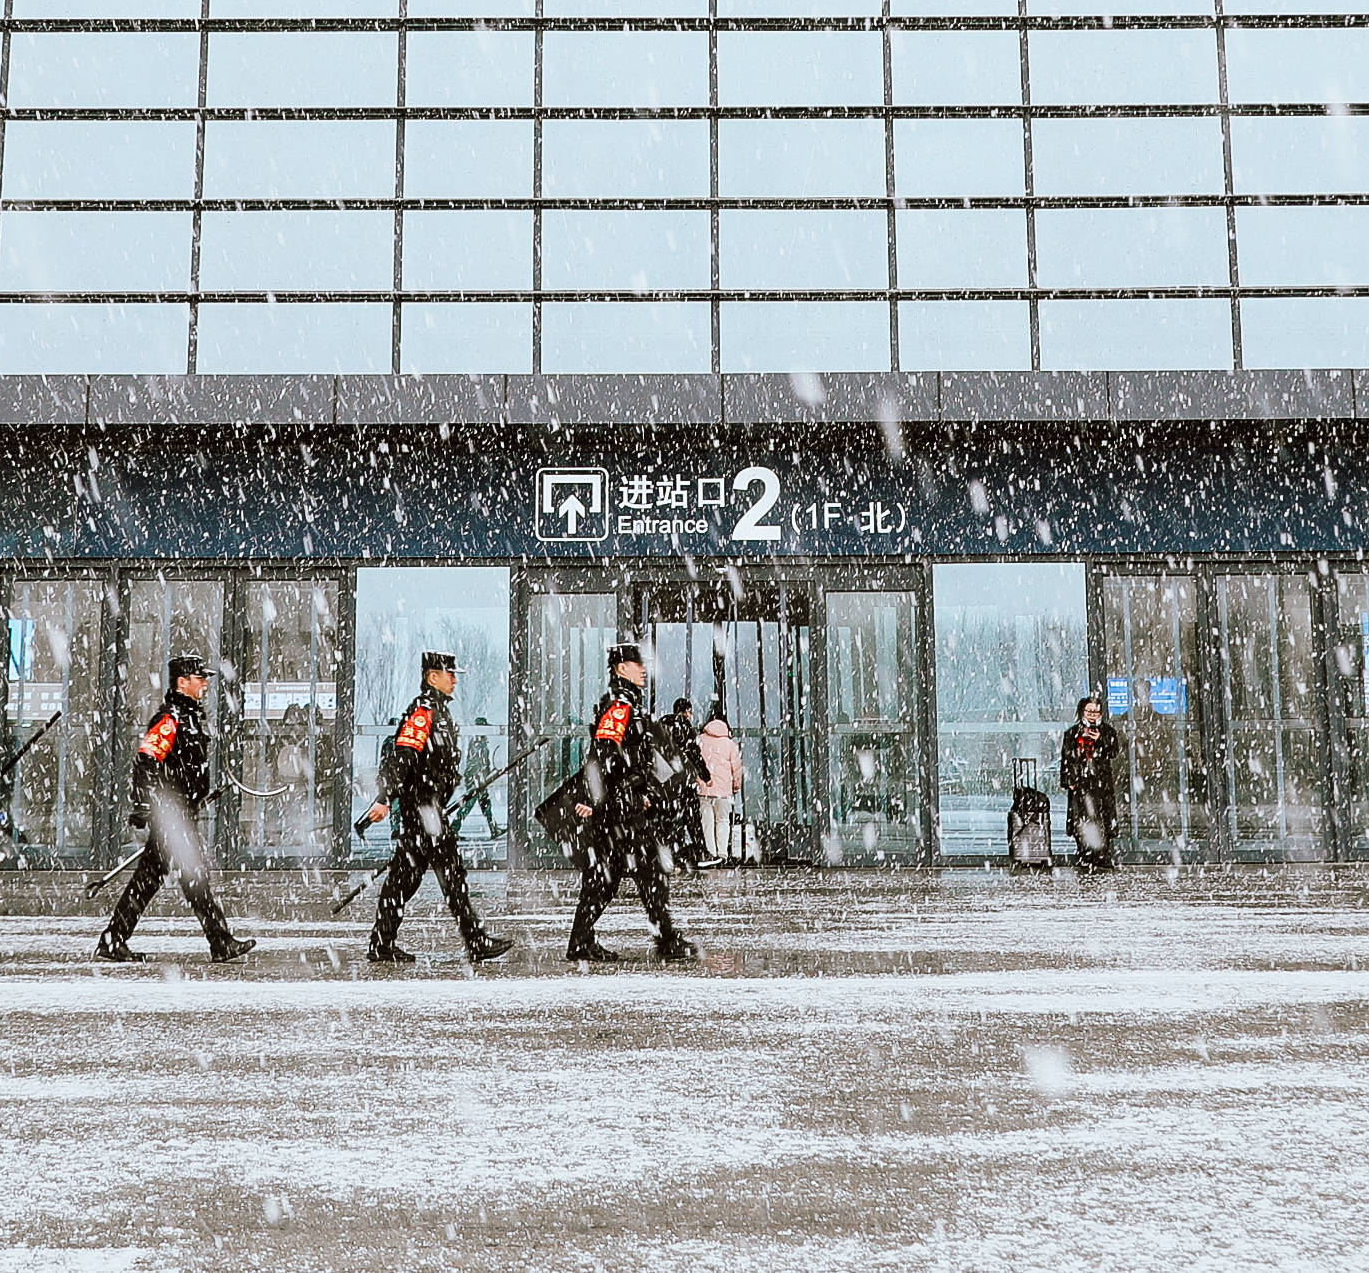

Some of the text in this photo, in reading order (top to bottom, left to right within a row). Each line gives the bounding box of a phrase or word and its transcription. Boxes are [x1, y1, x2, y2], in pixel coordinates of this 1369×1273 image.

[617, 516, 709, 534] Entrance
[618, 474, 725, 509] 进站口
[731, 466, 782, 541] 2
